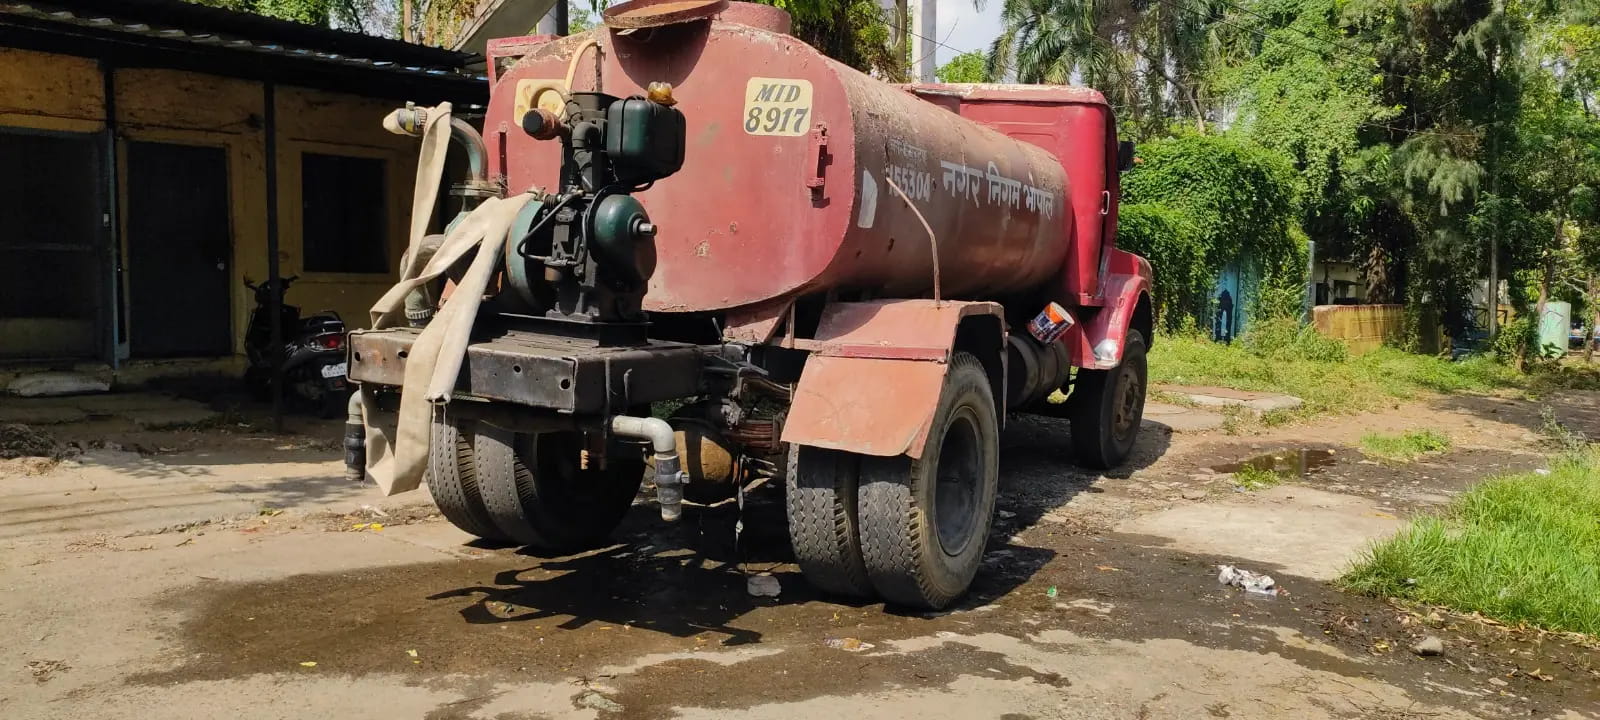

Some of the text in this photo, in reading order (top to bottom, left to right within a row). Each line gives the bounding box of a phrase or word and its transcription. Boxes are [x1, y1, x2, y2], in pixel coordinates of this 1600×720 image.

[753, 84, 801, 102] MID
[745, 107, 809, 133] 8917
[887, 164, 931, 202] 155304
[941, 160, 984, 208] नगर
[986, 160, 1022, 210] निगम
